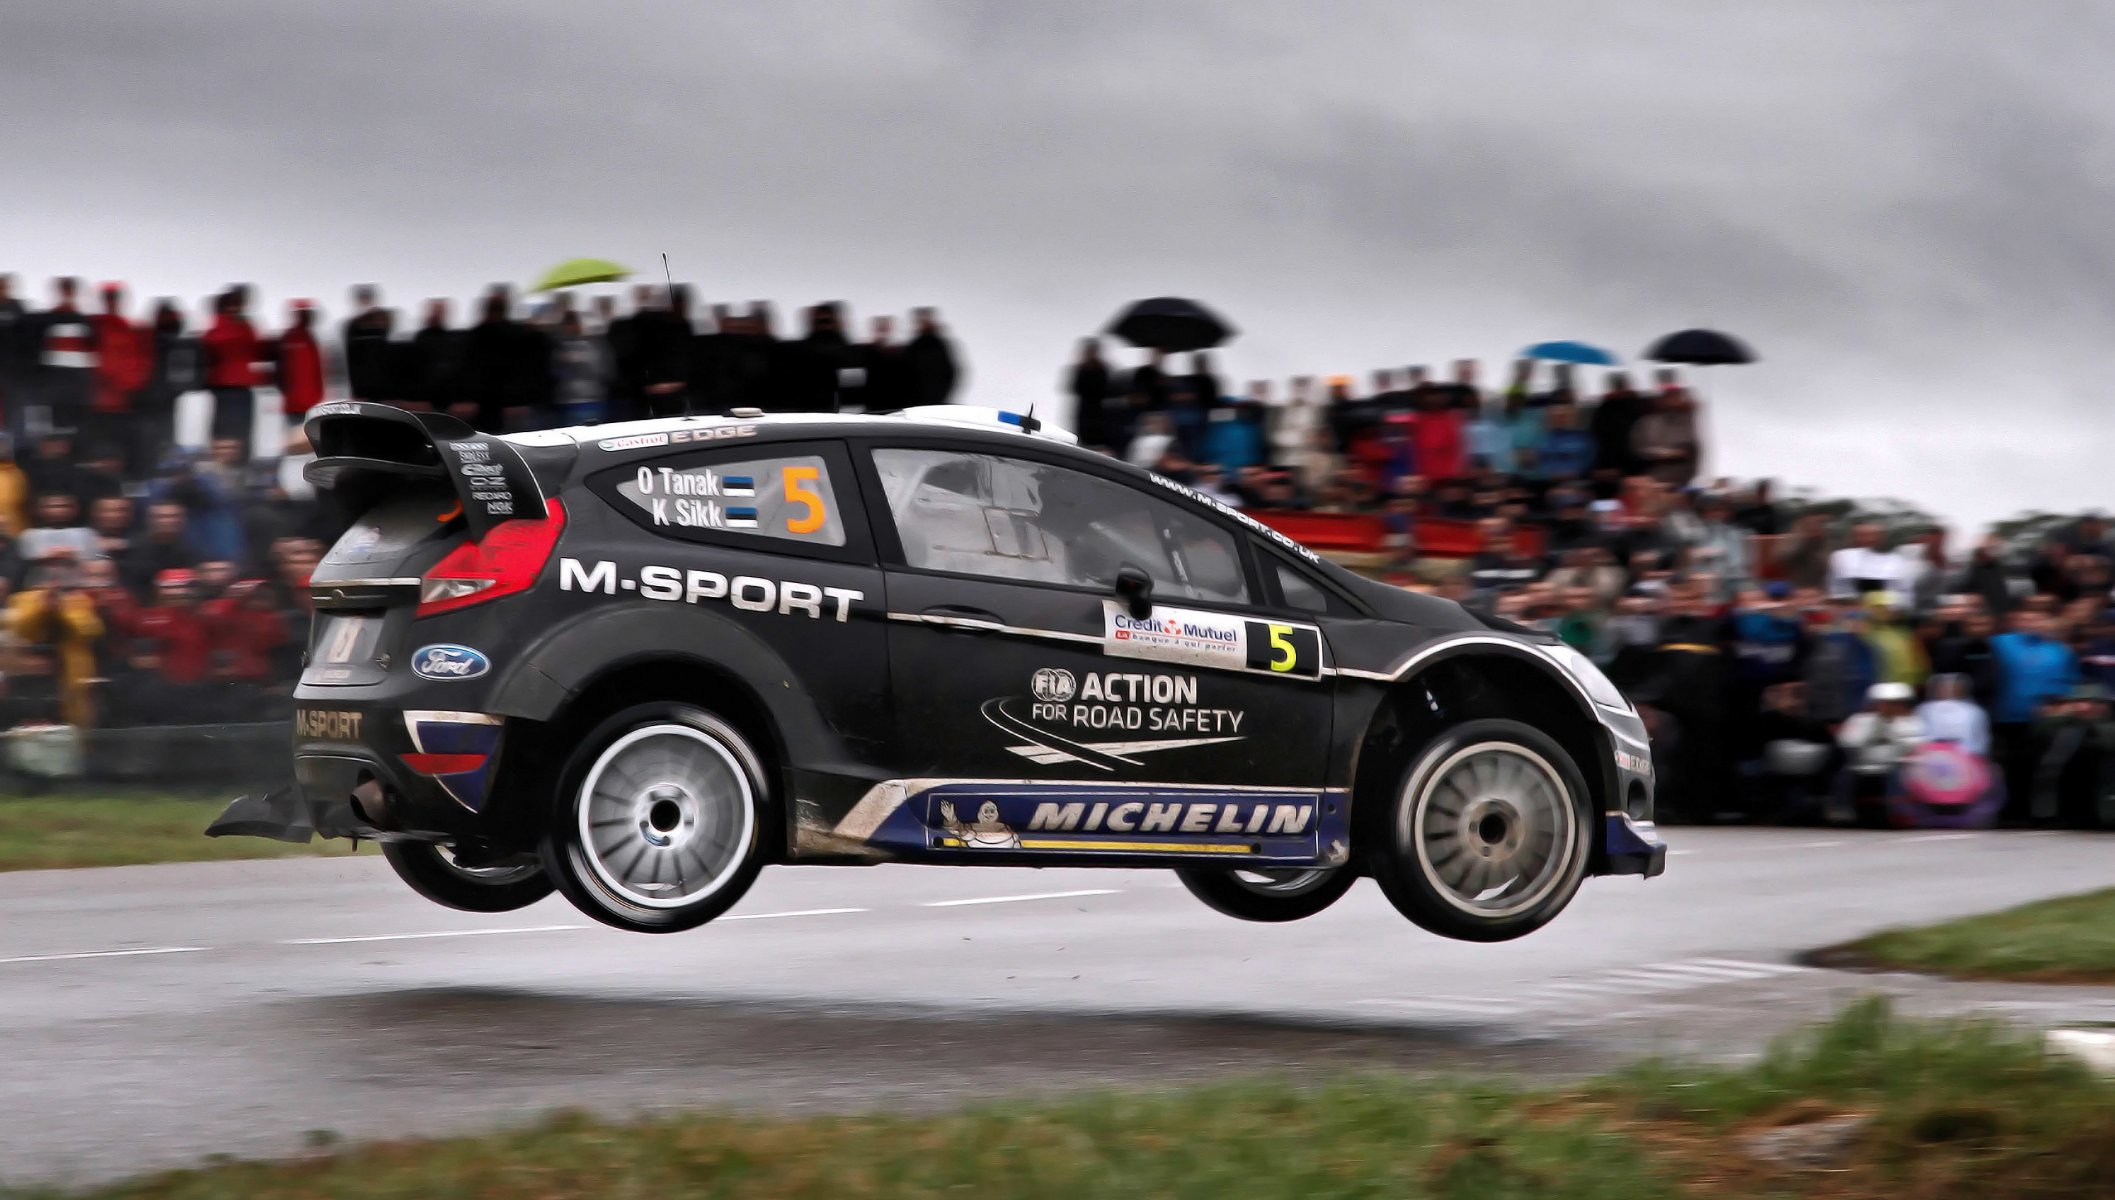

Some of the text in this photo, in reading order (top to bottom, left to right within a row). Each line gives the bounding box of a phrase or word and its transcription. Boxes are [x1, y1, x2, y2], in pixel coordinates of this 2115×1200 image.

[616, 424, 758, 449] Castrol EDGE
[636, 465, 721, 498] O Tanak
[651, 497, 724, 528] K Sikk
[781, 465, 827, 535] 5
[559, 557, 865, 623] M-SPORT
[1183, 623, 1238, 642] Mutuel
[1268, 624, 1297, 673] 5
[420, 648, 476, 676] Ford
[1033, 671, 1198, 704] FIA ACTION
[295, 708, 364, 740] M-SPORT
[1032, 703, 1245, 734] FOR ROAD SAFETY
[1027, 801, 1314, 834] MICHELIN
